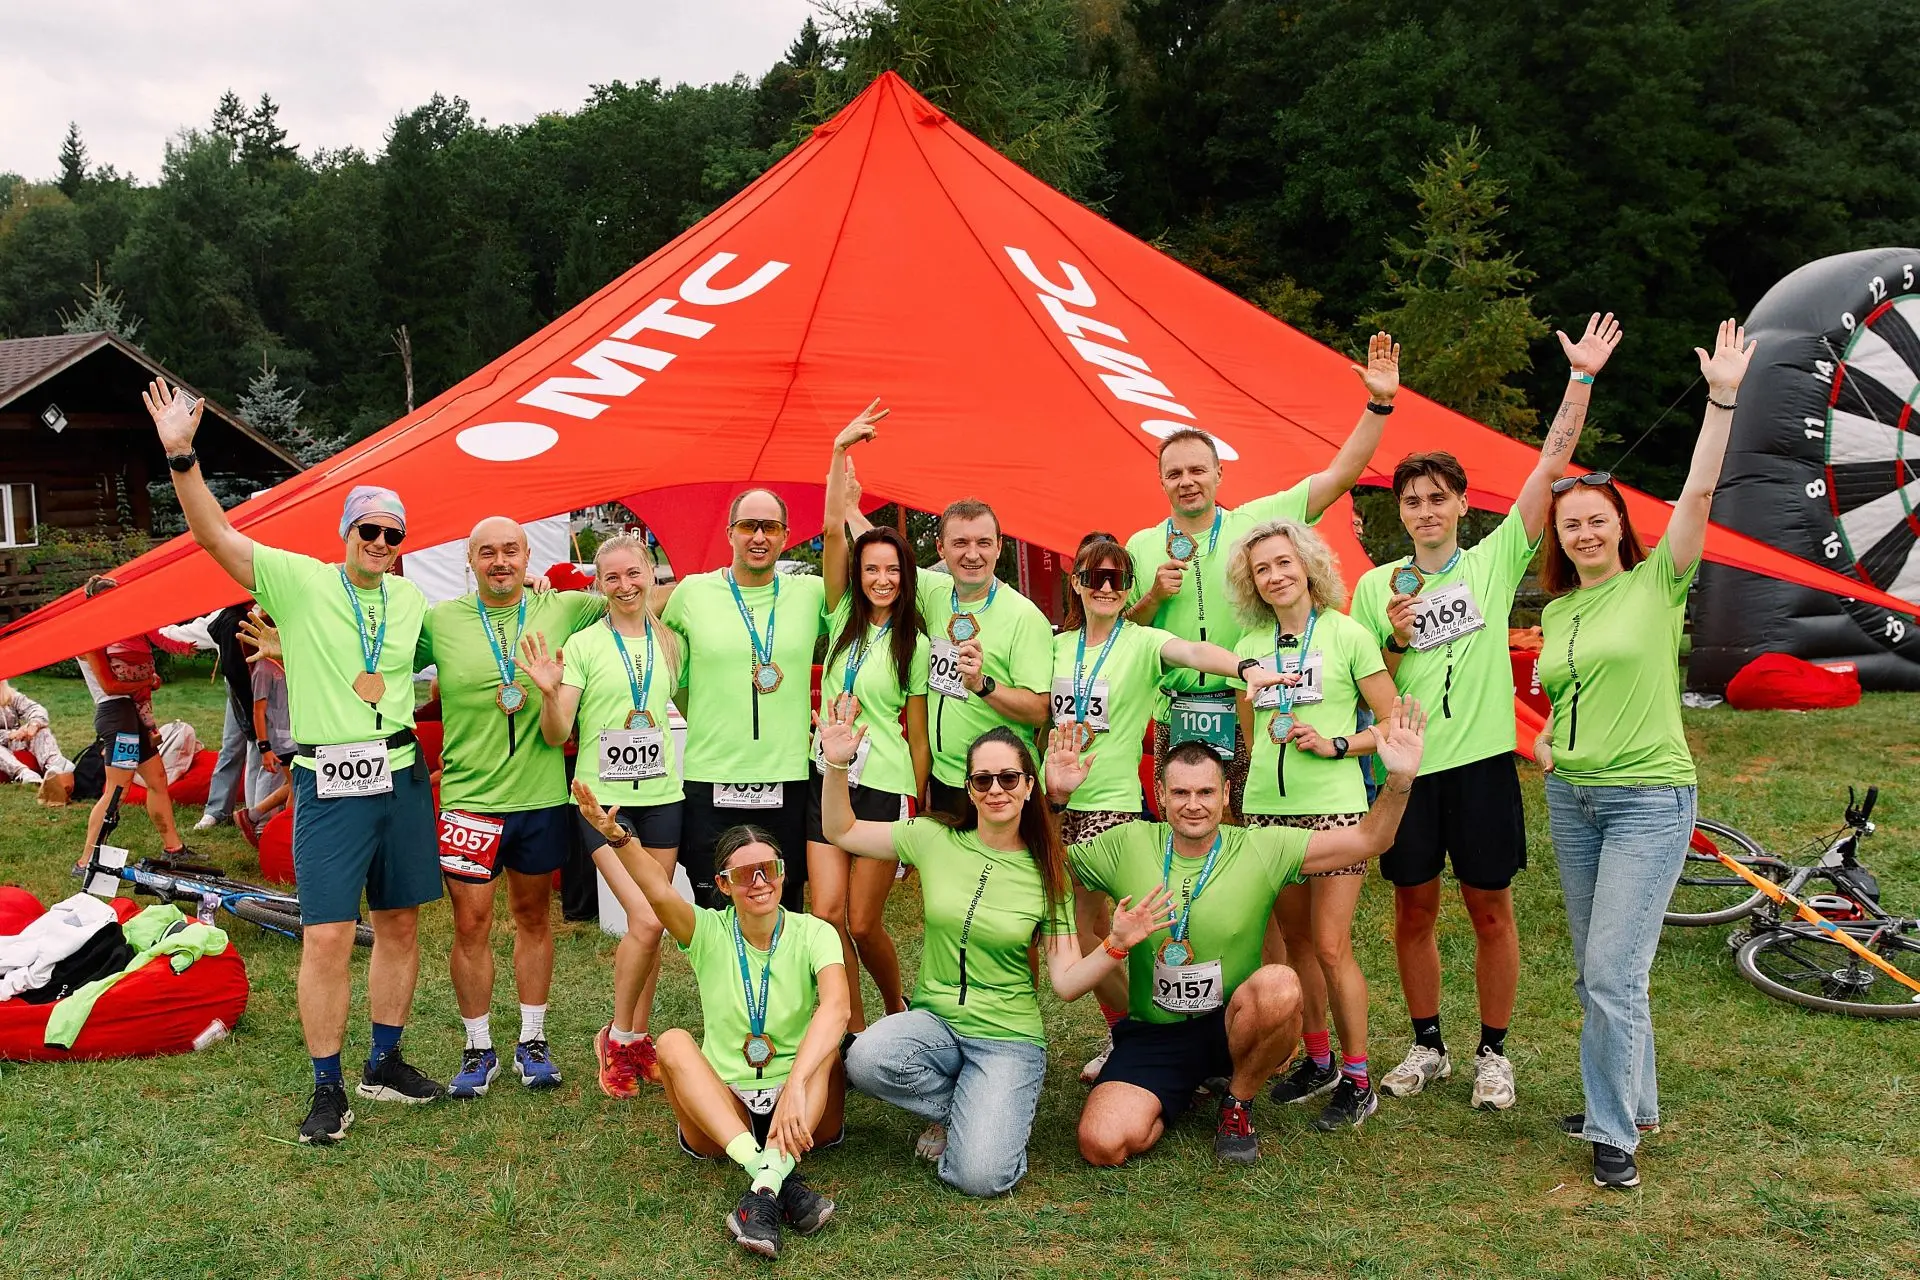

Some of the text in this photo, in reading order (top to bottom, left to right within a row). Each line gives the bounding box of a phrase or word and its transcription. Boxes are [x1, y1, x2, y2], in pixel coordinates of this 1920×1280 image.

[1869, 276, 1888, 305] 12
[1902, 264, 1915, 291] 5
[516, 250, 791, 420] МТС
[1003, 245, 1197, 420] МТС
[1841, 312, 1856, 335] 9
[1812, 359, 1836, 385] 14
[1804, 417, 1825, 441] 11
[1805, 478, 1827, 499] 8
[1821, 531, 1843, 560] 16
[1043, 549, 1052, 572] АЕТ
[1412, 599, 1467, 635] 9169
[930, 654, 963, 683] 905
[1054, 694, 1103, 717] 923
[1180, 711, 1222, 733] 1101
[607, 744, 660, 765] 9019
[322, 757, 385, 782] 9007
[440, 823, 496, 852] 2057
[960, 863, 994, 945] #силакомандыМТС
[1158, 978, 1214, 999] 9157
